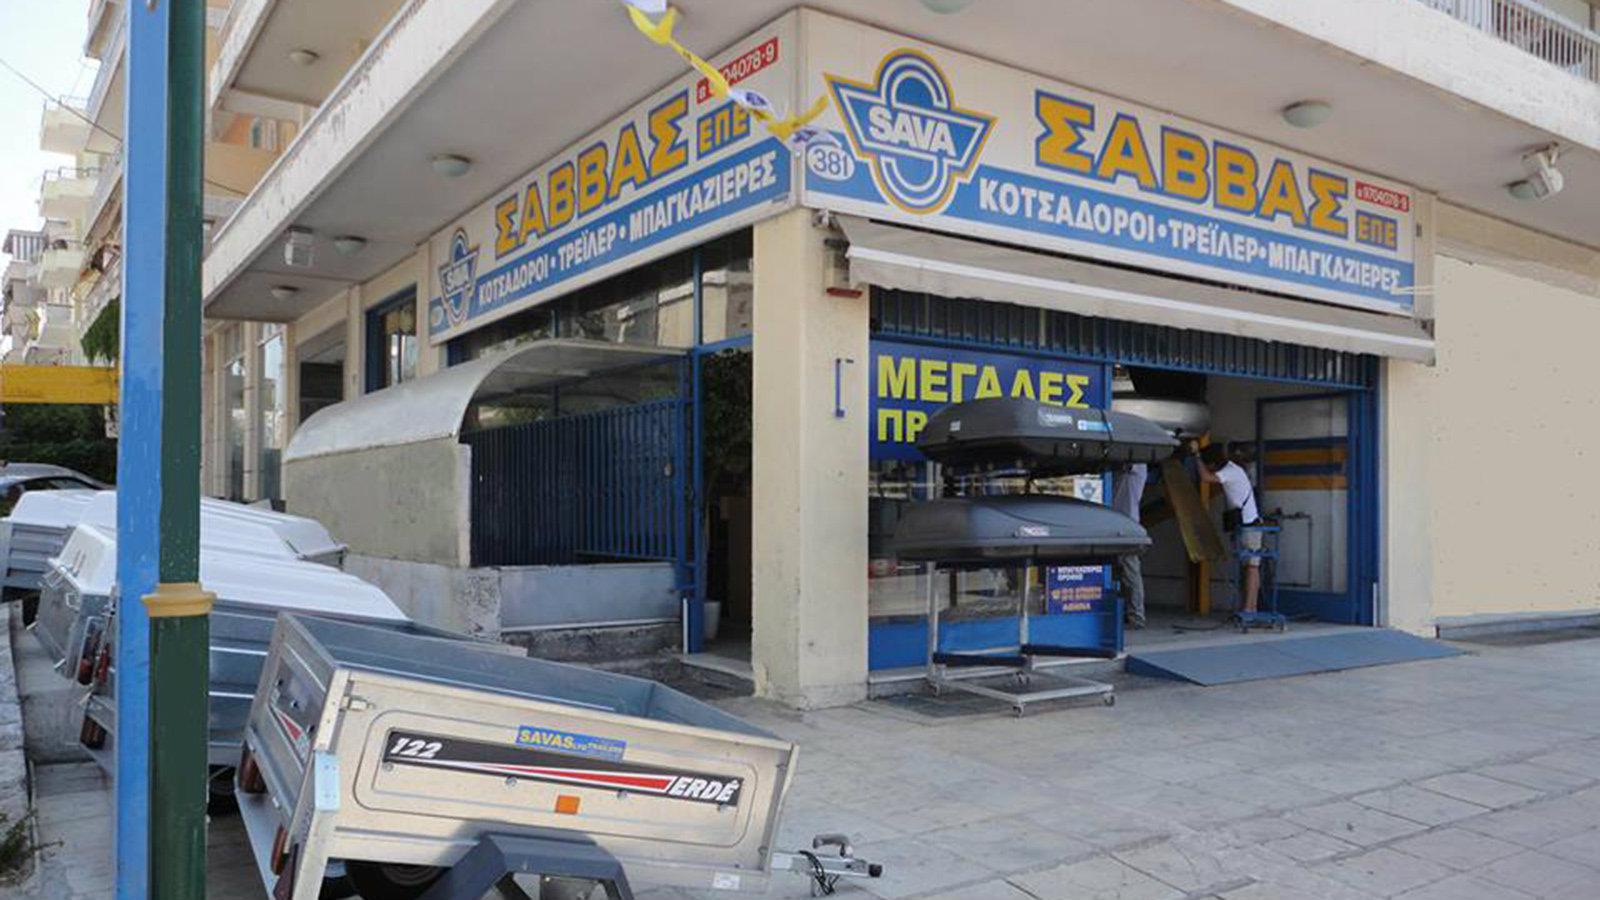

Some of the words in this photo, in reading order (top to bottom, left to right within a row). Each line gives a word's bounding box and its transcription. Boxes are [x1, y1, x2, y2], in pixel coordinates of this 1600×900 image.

[869, 106, 957, 157] SAVA
[495, 88, 689, 260] ΣΑΒΒΑΣ
[698, 102, 749, 155] ΕΠΕ
[813, 148, 849, 177] 381
[1035, 89, 1349, 239] ΣΑΒΒΑΣ
[1357, 212, 1397, 247] ΕΠΕ
[479, 254, 549, 306] ΚΟΤΣΑΔΟΡΟΙ
[558, 223, 617, 270] ΤΡΕΪΛΕΡ
[630, 150, 777, 242] ΜΠΑΓΚΑΖΙΕΡΕΣ
[979, 177, 1155, 242] ΚΟΤΣΑΔΟΡΟΙ
[1167, 219, 1260, 263] ΤΡΕΪΛΕΡ
[1268, 241, 1401, 295] ΜΠΑΓΚΑΖΙΕΡΕΣ
[877, 354, 1090, 409] ΜΕΓΑΛΕΣ
[391, 738, 442, 758] 122
[520, 729, 574, 749] SAVAS
[668, 776, 740, 802] ERDÉ
